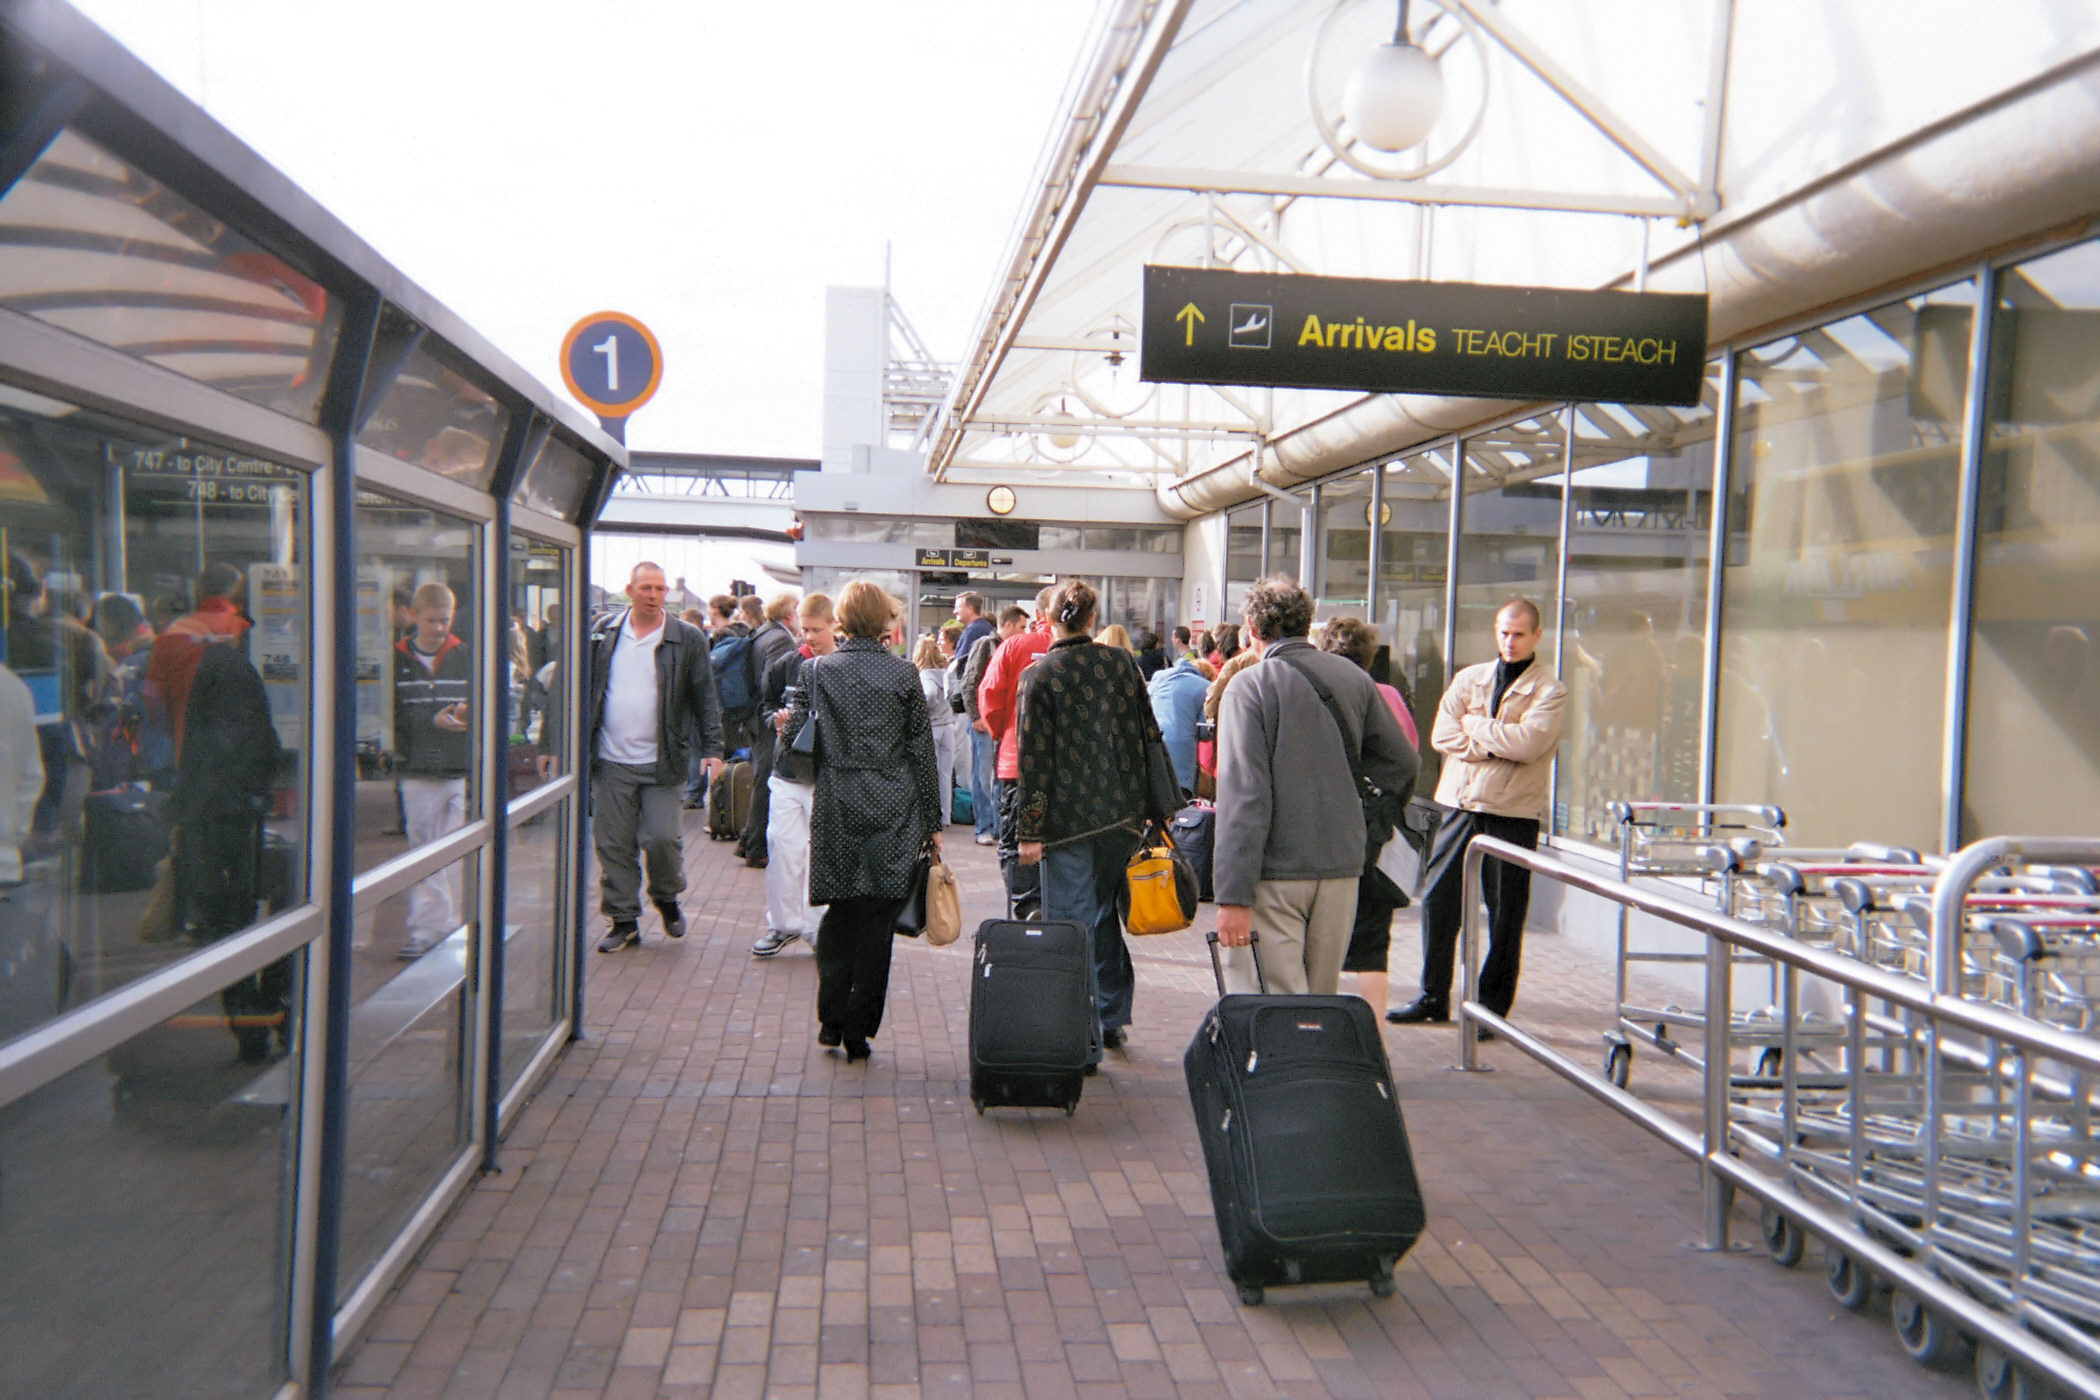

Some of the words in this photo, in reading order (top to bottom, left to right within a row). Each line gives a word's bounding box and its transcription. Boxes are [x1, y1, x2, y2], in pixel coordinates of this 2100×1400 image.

[1298, 314, 1437, 353] Arrivals
[1452, 328, 1558, 360] TEACHT
[1566, 334, 1677, 366] ISTEACH
[593, 336, 617, 389] 1
[134, 451, 164, 470] 747
[176, 455, 191, 471] to
[195, 455, 223, 476] City
[226, 456, 273, 475] Centre
[187, 480, 216, 499] 748
[229, 484, 243, 500] to
[922, 557, 945, 566] Arrivals
[955, 558, 987, 567] Departures
